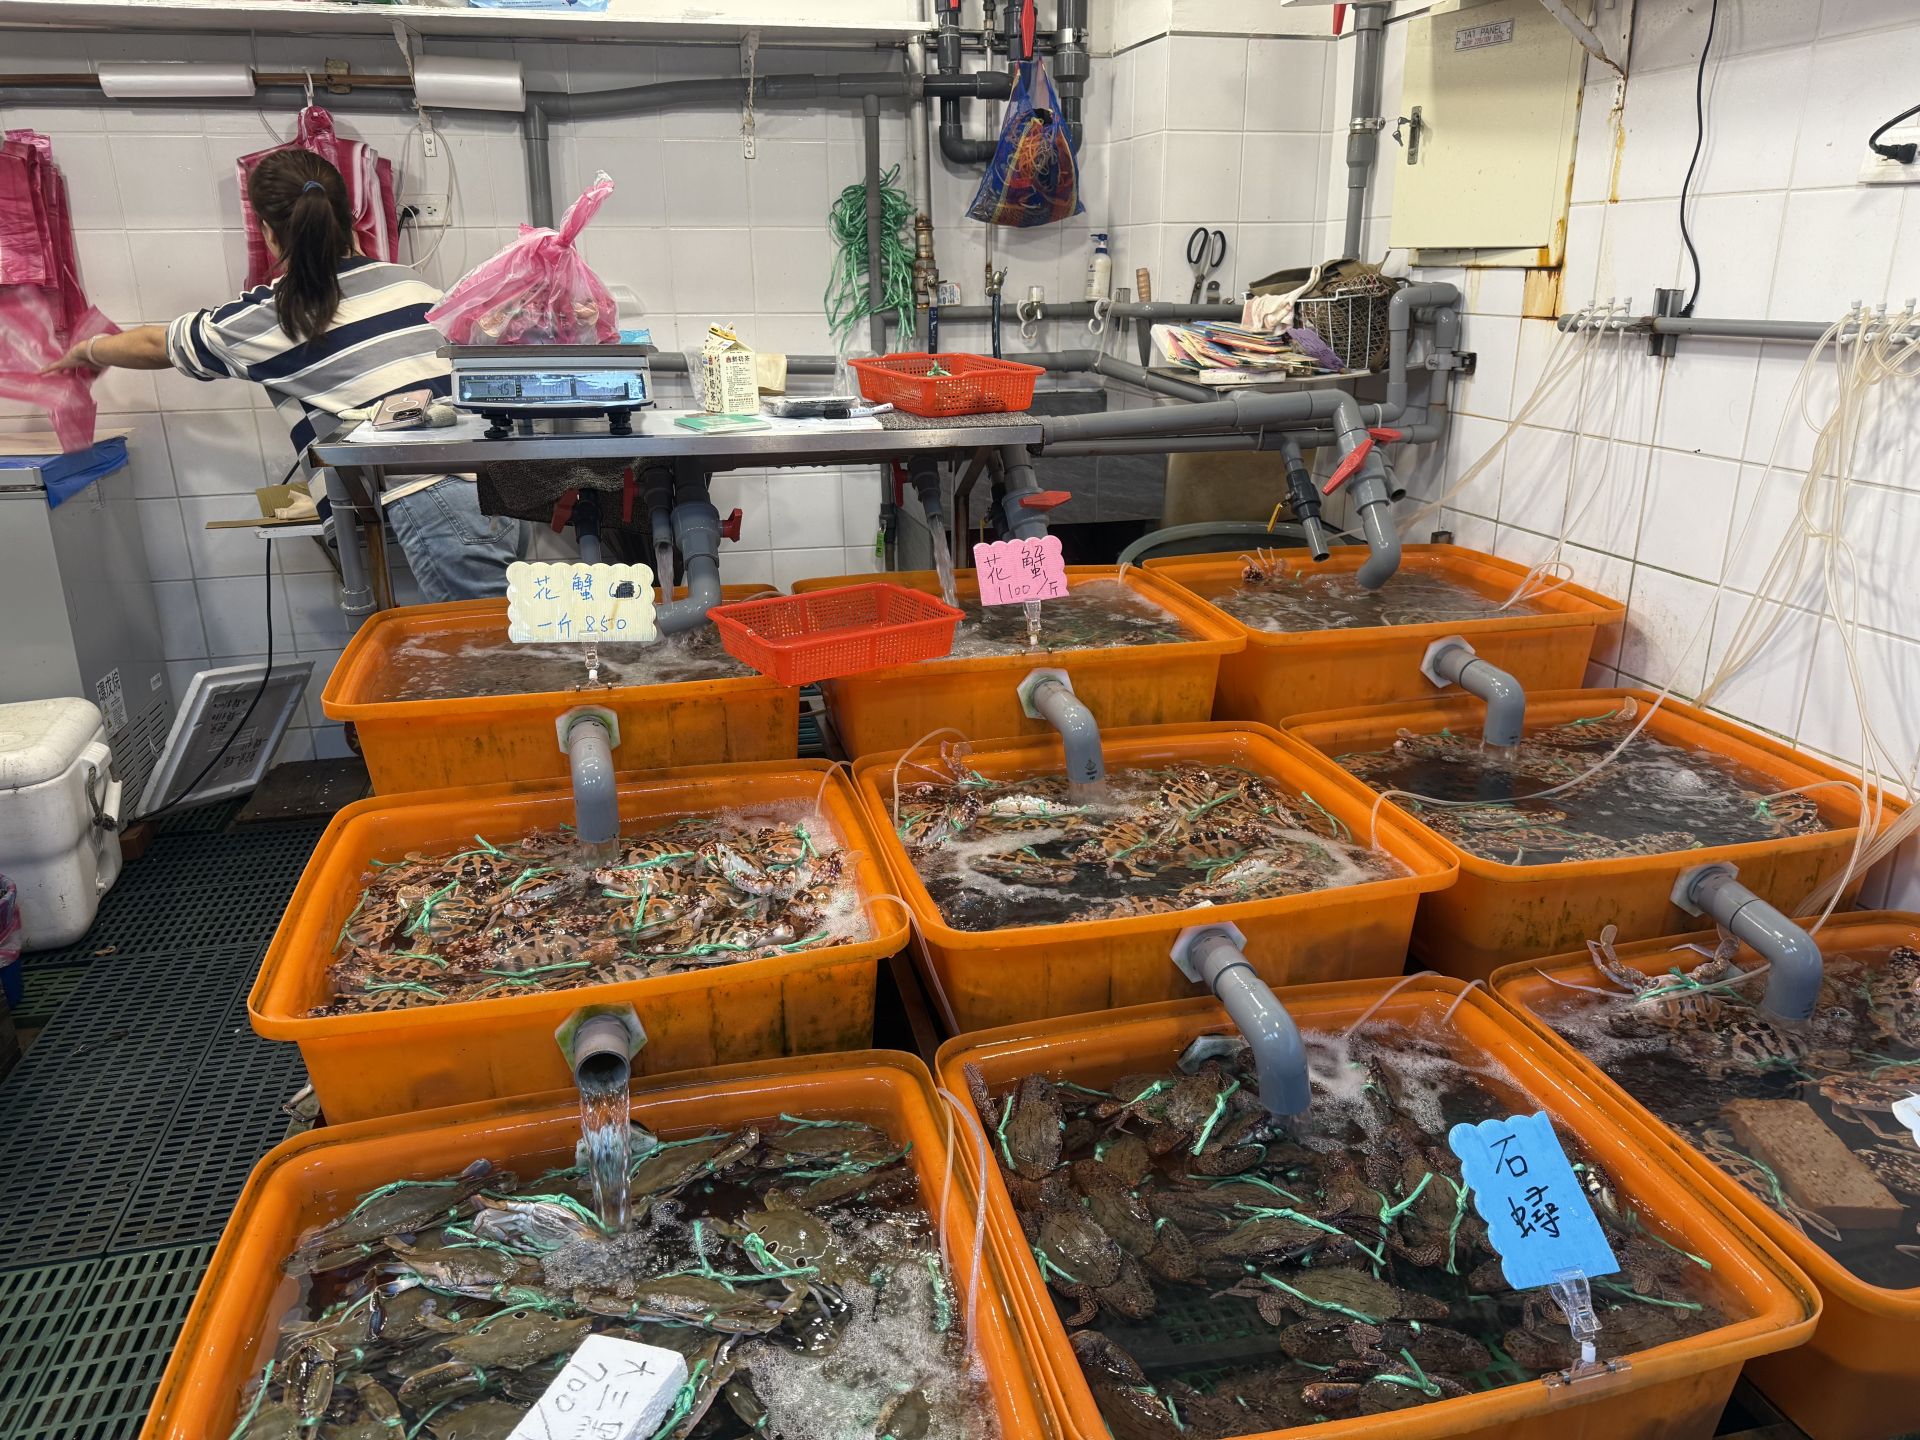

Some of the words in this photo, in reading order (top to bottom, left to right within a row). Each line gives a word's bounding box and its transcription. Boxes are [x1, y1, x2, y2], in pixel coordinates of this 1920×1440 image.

[1481, 25, 1504, 36] PANEL
[732, 355, 750, 363] 鮮奶茶
[984, 545, 1046, 584] 花蟹
[534, 573, 594, 600] 花蟹
[585, 615, 627, 633] 850
[96, 671, 120, 701] 環戊烷
